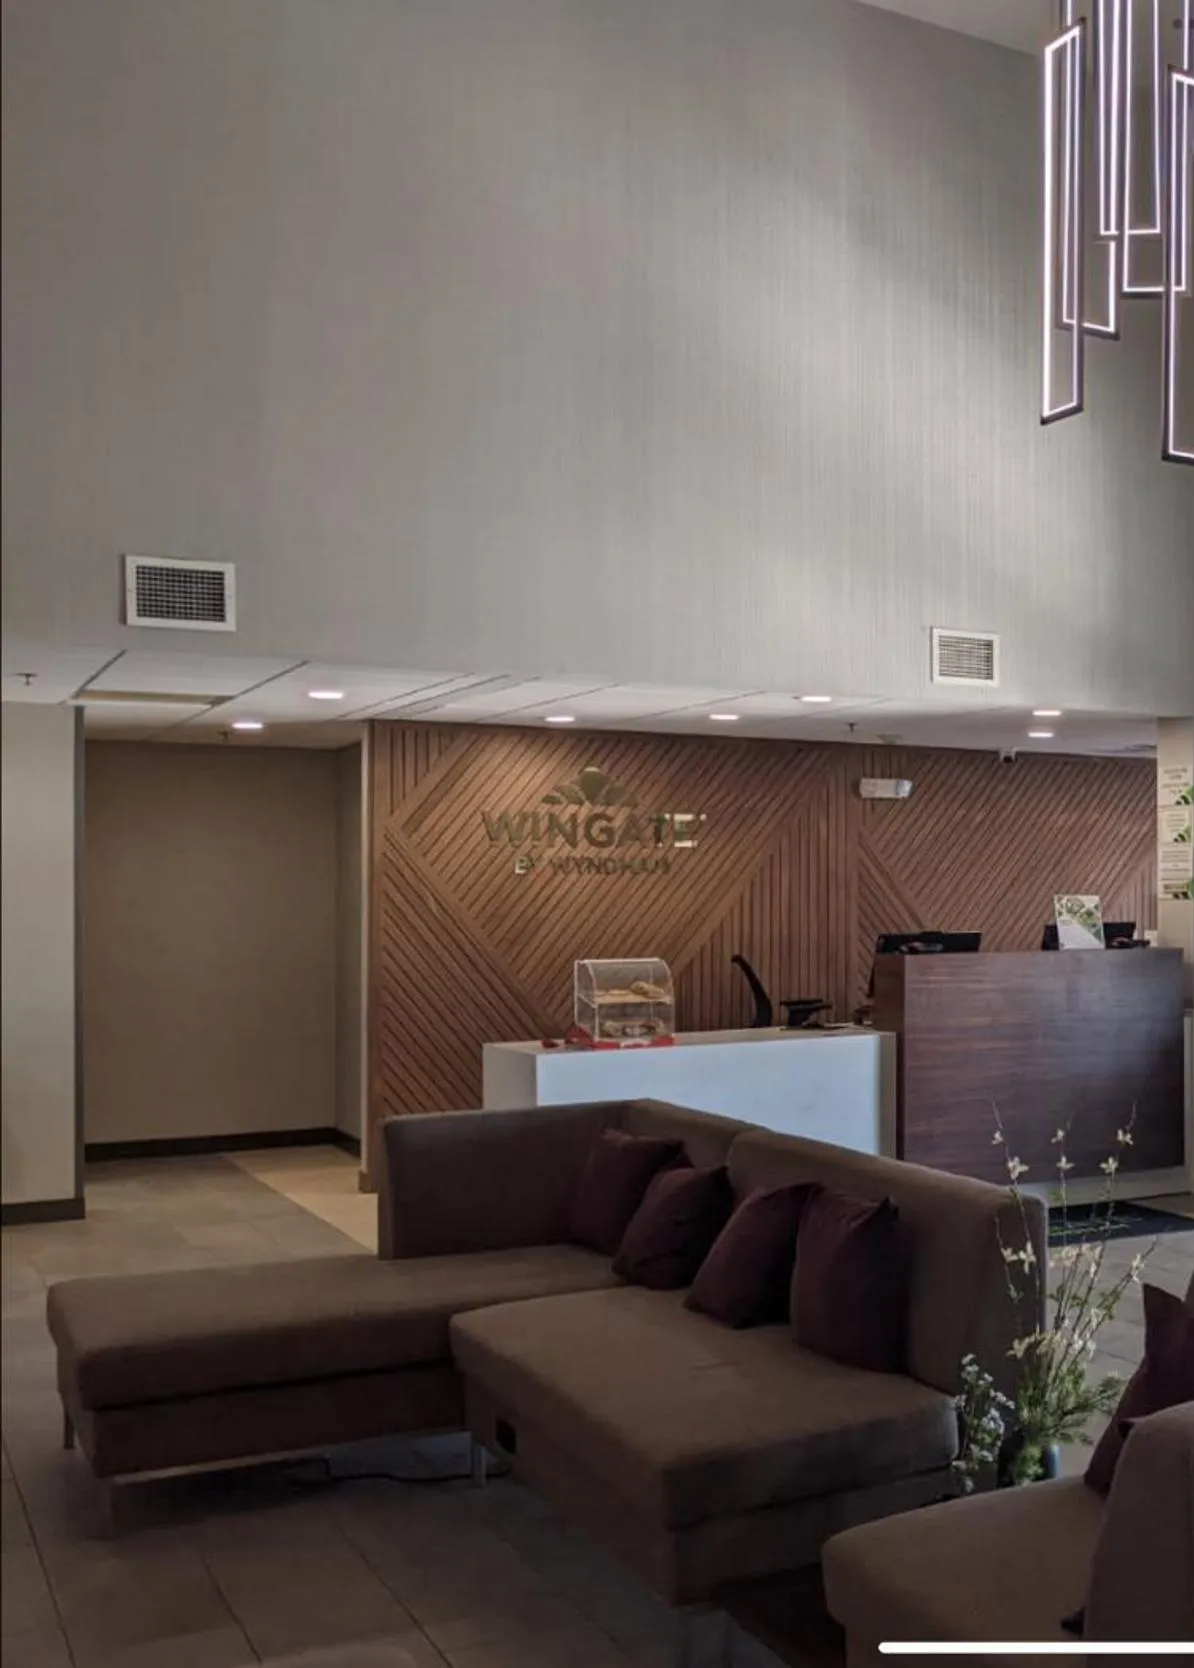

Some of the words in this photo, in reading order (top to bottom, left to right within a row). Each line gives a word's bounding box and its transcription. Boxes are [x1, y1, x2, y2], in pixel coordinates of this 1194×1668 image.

[481, 810, 699, 849] WINGATE
[514, 856, 535, 875] BY
[550, 855, 672, 876] WYNDHAM
